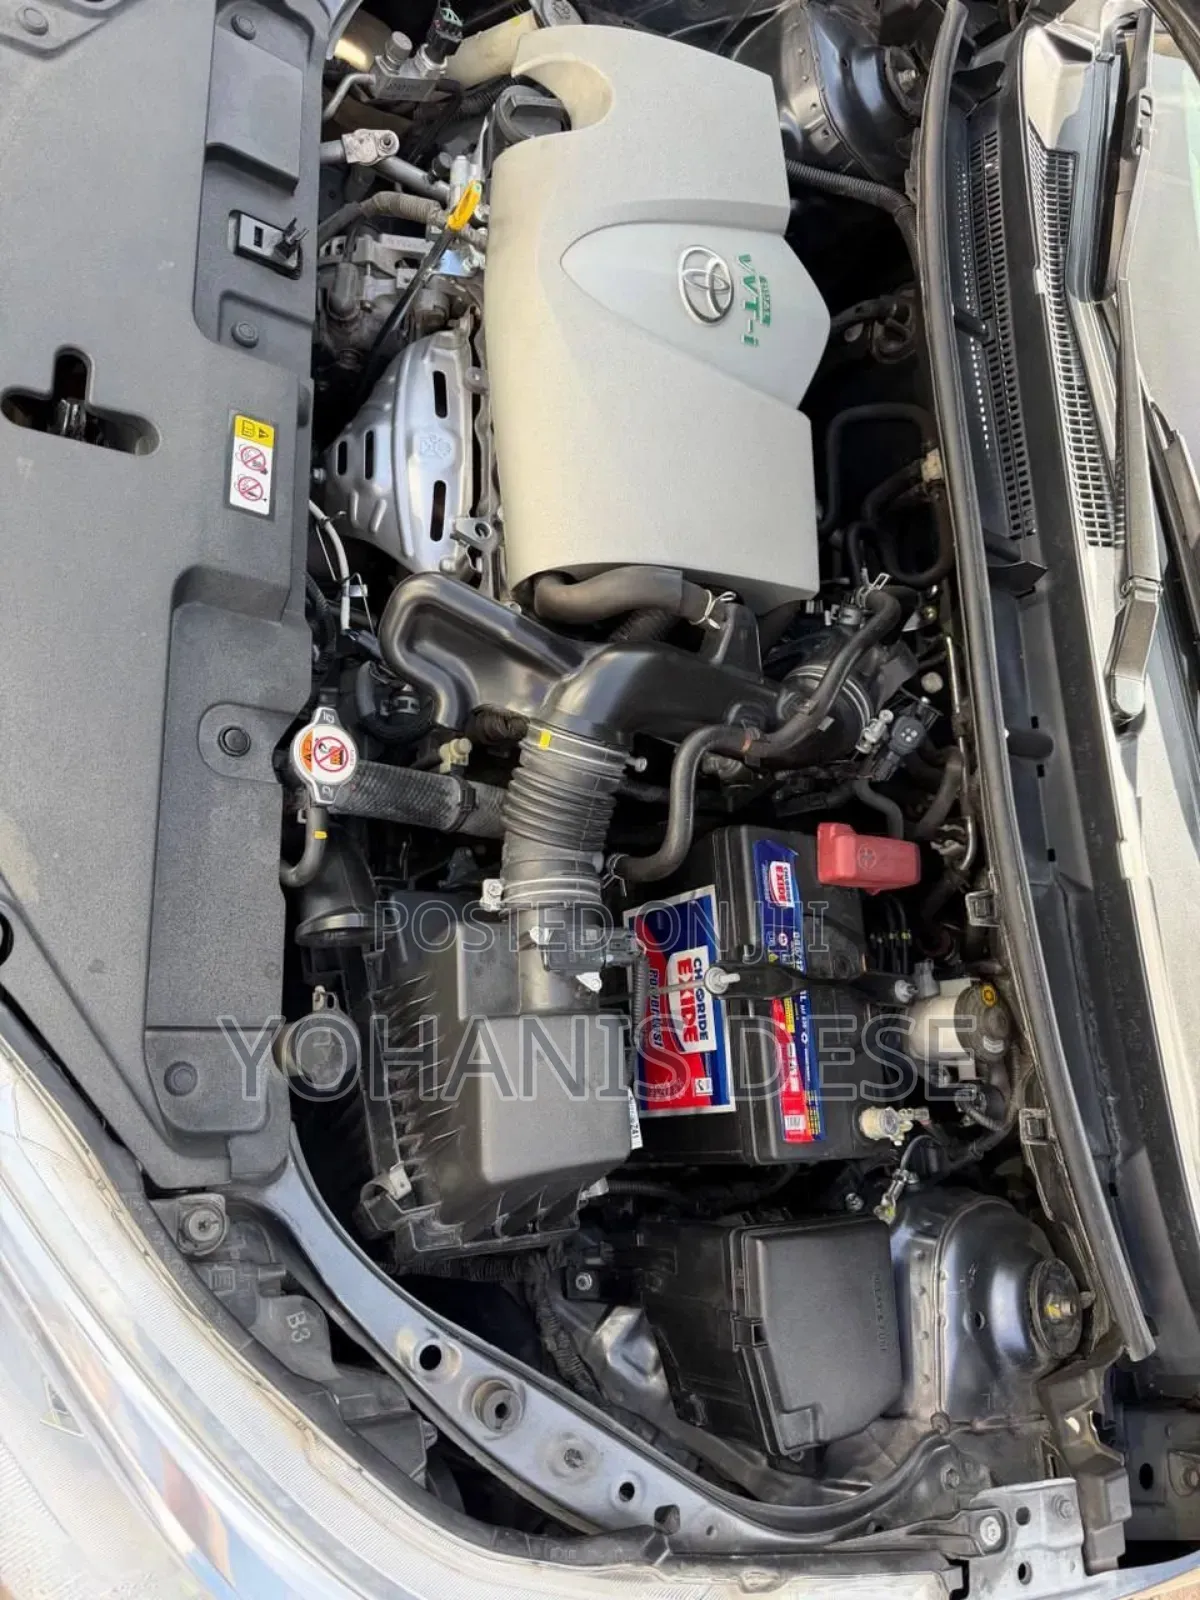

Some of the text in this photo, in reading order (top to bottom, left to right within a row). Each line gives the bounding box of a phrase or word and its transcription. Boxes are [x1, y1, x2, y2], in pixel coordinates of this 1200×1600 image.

[737, 254, 759, 346] VVT-i
[775, 865, 788, 902] EXIDE
[677, 957, 700, 1042] EXIDE
[693, 956, 709, 1041] CHORIDE
[286, 1310, 311, 1342] B3
